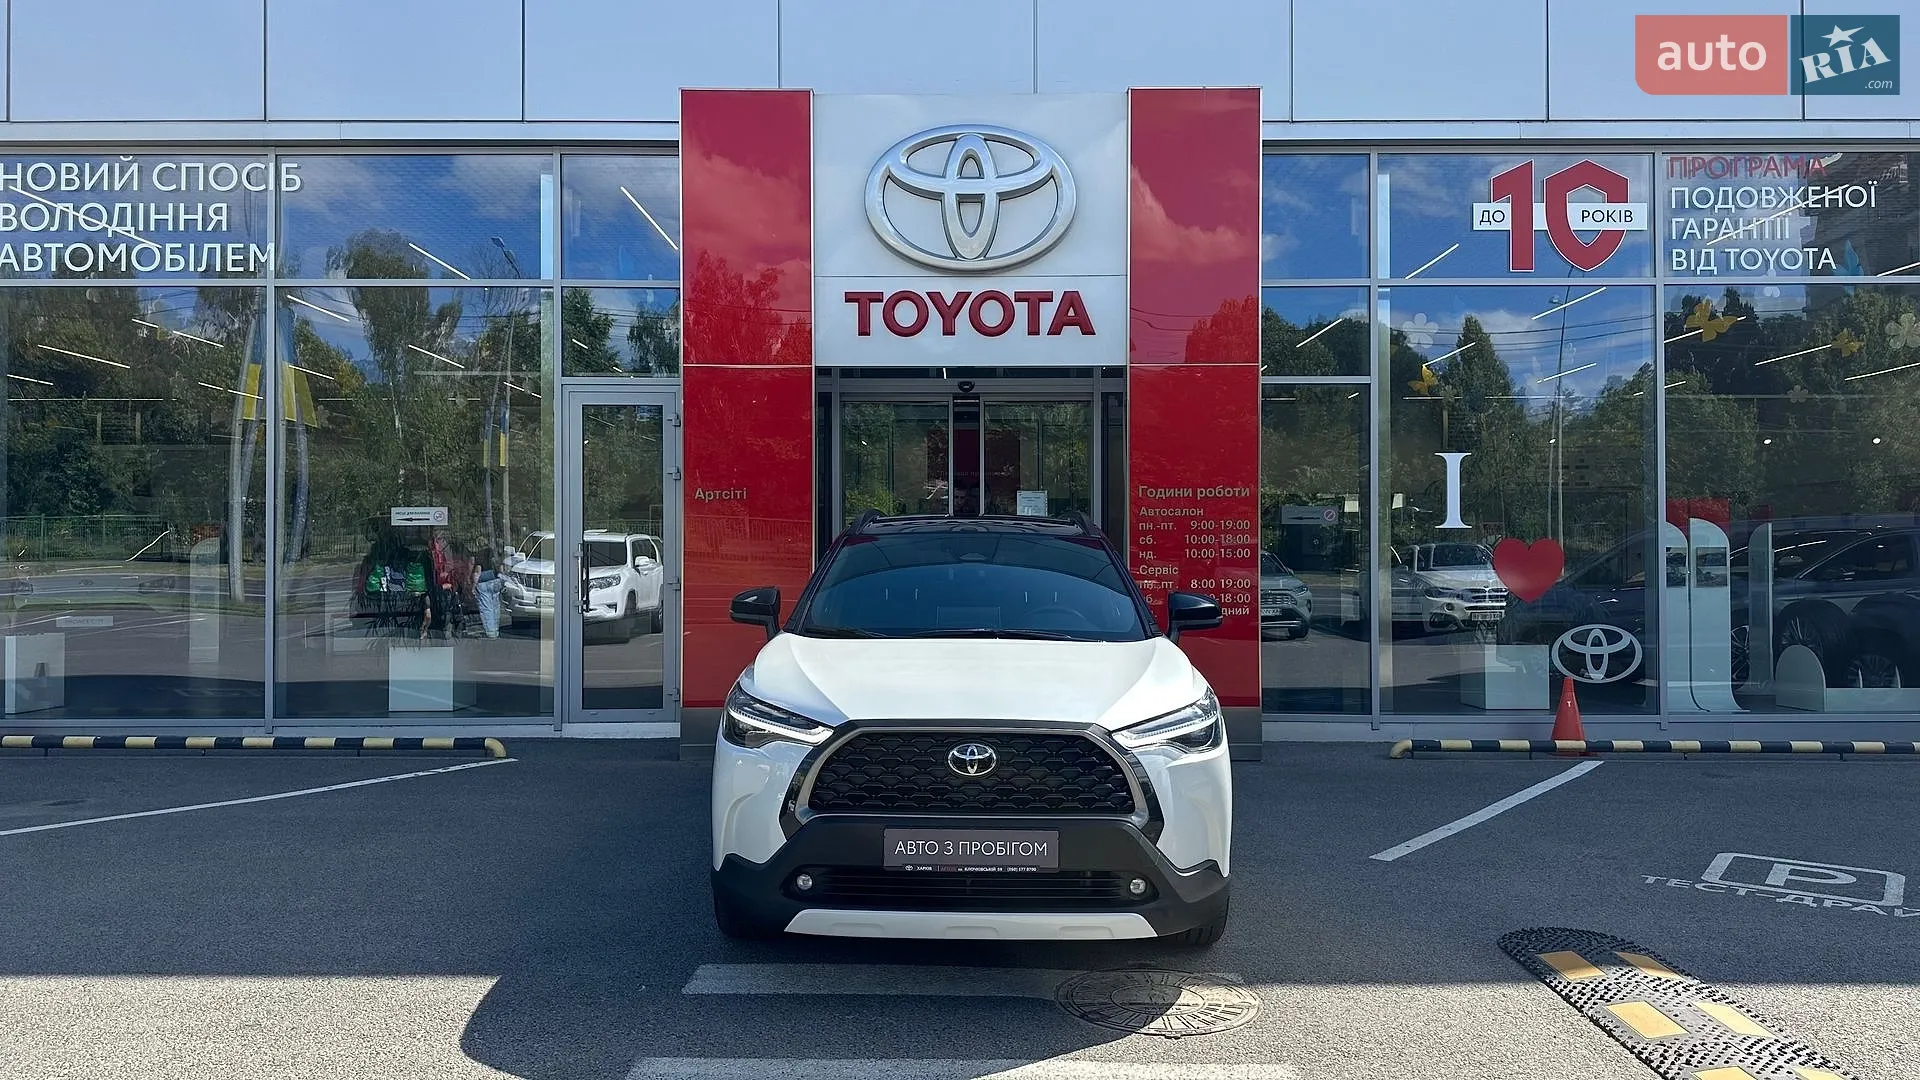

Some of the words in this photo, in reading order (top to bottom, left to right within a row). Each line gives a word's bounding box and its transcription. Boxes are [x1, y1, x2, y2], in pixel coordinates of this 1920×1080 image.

[0, 155, 139, 191] НОВИЙ
[152, 162, 302, 192] СПОСІБ
[1668, 156, 1828, 178] ПРОГРАМА
[1671, 180, 1878, 213] ПОДОВЖЕНОЇ
[0, 202, 228, 238] ВОЛОДІННЯ
[1479, 210, 1506, 226] ДО
[1581, 210, 1634, 223] РОКІВ
[1671, 212, 1790, 240] ГАРАНТІЇ
[0, 243, 275, 272] АВТОМОБІЛЕМ
[1672, 248, 1717, 275] ВІД
[1725, 248, 1837, 270] TOYOTA
[844, 290, 1096, 337] TOYOTA
[695, 487, 747, 503] Артсіті
[1138, 485, 1192, 499] Години
[1197, 485, 1250, 500] роботи
[1139, 506, 1204, 516] Автосалон
[1139, 534, 1156, 544] сб.
[1185, 534, 1250, 544] 10:00-18:00
[1139, 551, 1157, 560] нд.
[1185, 549, 1250, 558] 10:00-15:00
[1139, 564, 1179, 576] Сервіс
[894, 840, 939, 855] АВТО
[959, 841, 1047, 857] ПРОБІГОМ
